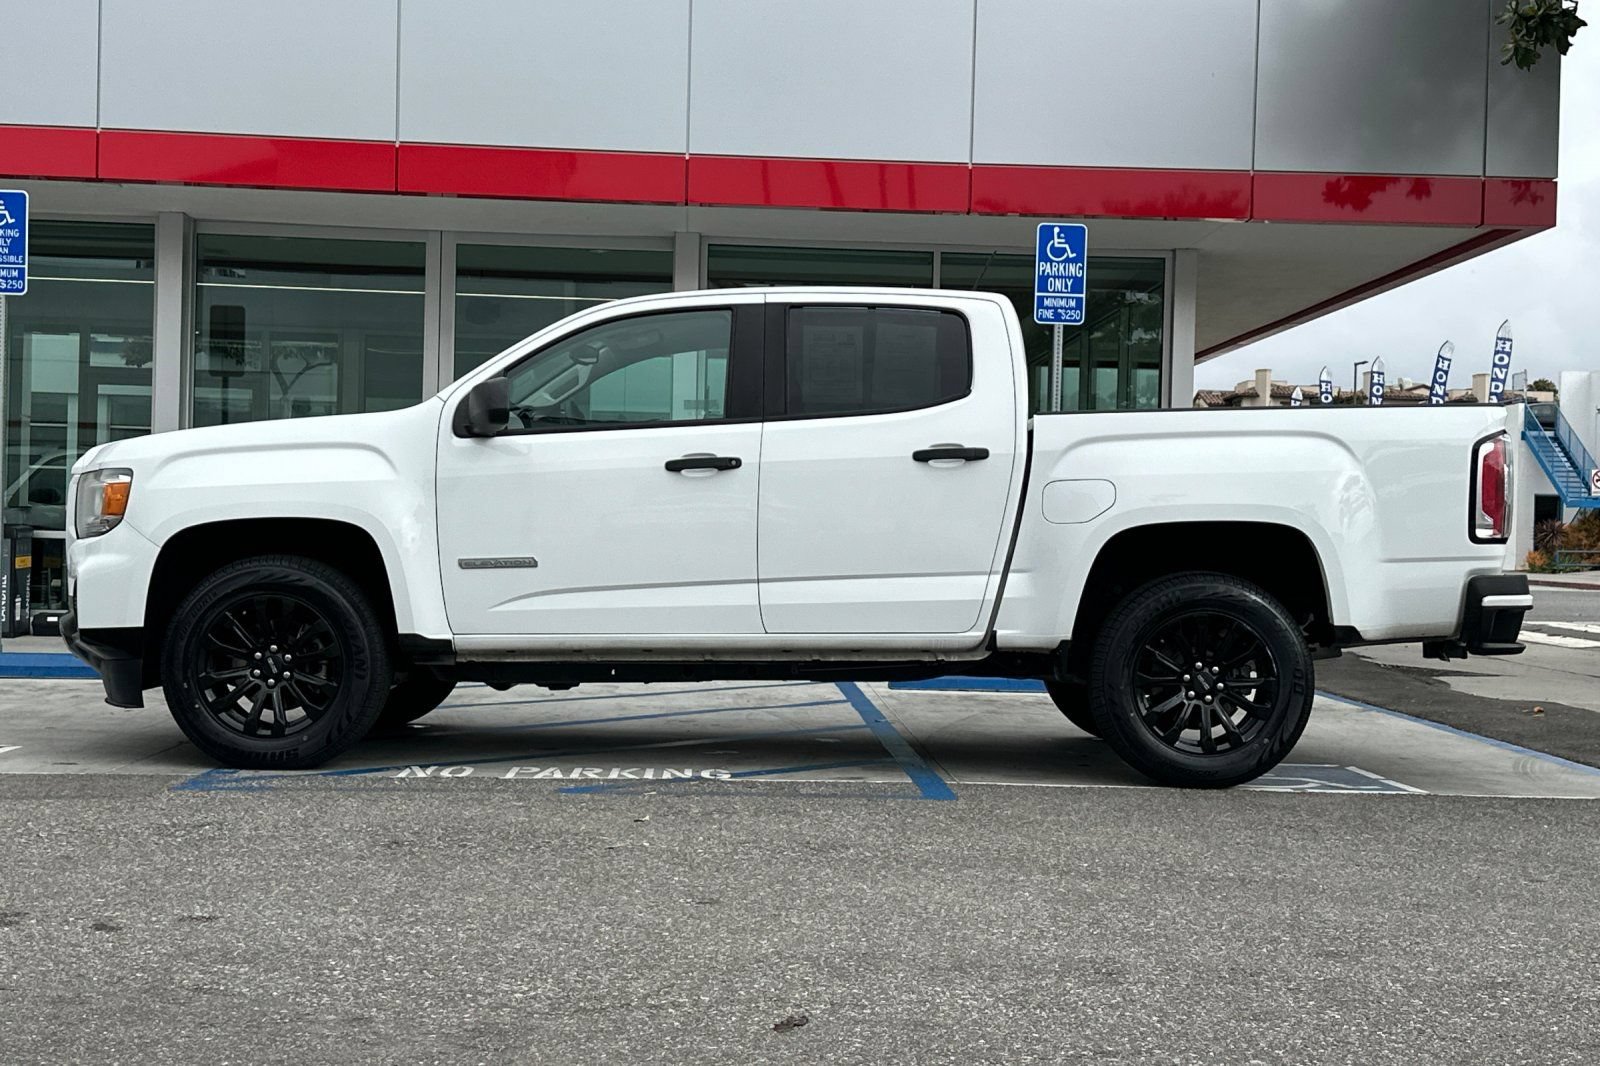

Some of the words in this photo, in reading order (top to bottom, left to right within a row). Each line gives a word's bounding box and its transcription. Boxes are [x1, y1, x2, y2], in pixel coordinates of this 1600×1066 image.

[1039, 262, 1083, 277] PARKING
[1047, 278, 1073, 292] ONLY
[1043, 298, 1076, 308] MINIMUM
[1038, 309, 1054, 319] FINE
[1321, 382, 1333, 403] HO
[462, 558, 536, 568] ELEVATION
[396, 765, 475, 778] NO
[504, 766, 732, 779] PARKING
